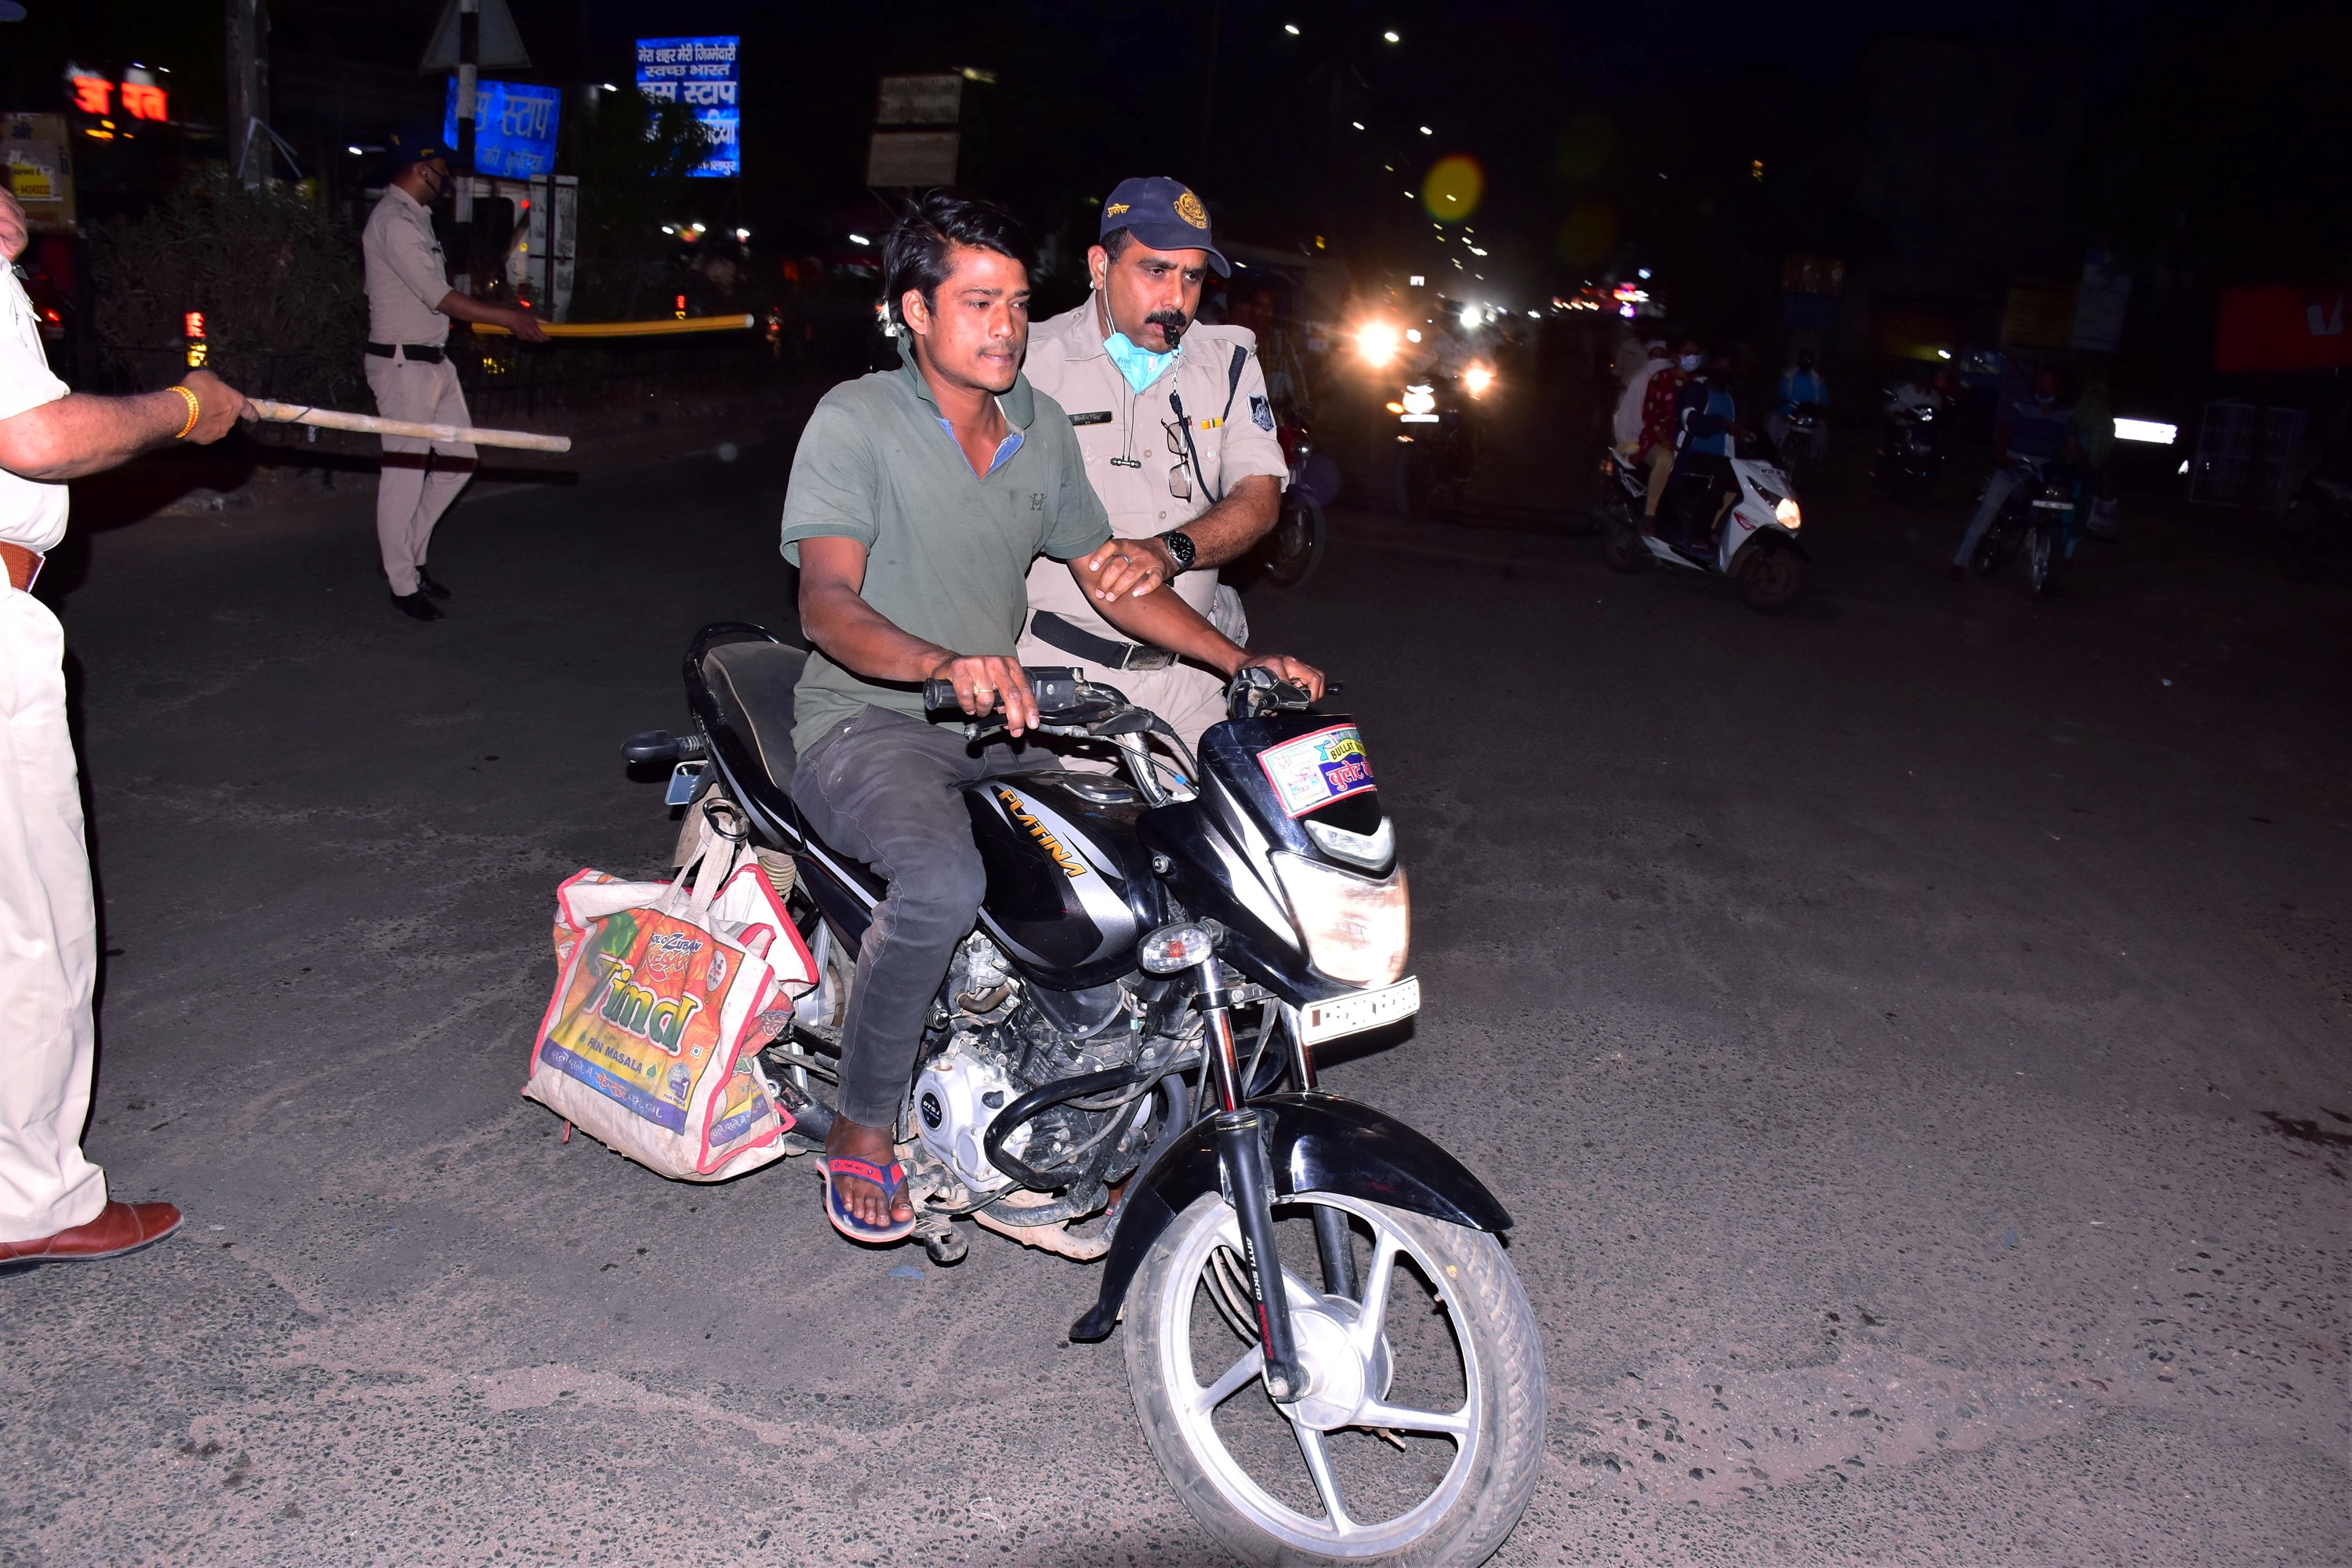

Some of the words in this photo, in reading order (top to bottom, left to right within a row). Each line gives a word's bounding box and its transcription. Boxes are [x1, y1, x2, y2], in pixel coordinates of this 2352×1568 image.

[638, 45, 654, 62] मेरा
[655, 47, 677, 63] शहर
[677, 44, 693, 62] मेरी
[695, 42, 735, 61] जिम्मेदारी
[644, 64, 687, 77] स्वच्छ
[690, 64, 730, 76] भारत
[684, 81, 737, 105] स्टाप
[502, 95, 554, 139] स्टाप
[1107, 203, 1130, 218] पुलिस
[1330, 742, 1354, 760] BULLAT
[1326, 760, 1363, 791] बुलेट
[998, 788, 1087, 877] PLATINA
[587, 1036, 603, 1052] PAN
[604, 1046, 643, 1074] MASALA
[662, 1093, 673, 1102] PAN
[1245, 1236, 1258, 1269] ANTI
[1252, 1270, 1265, 1301] SKID
